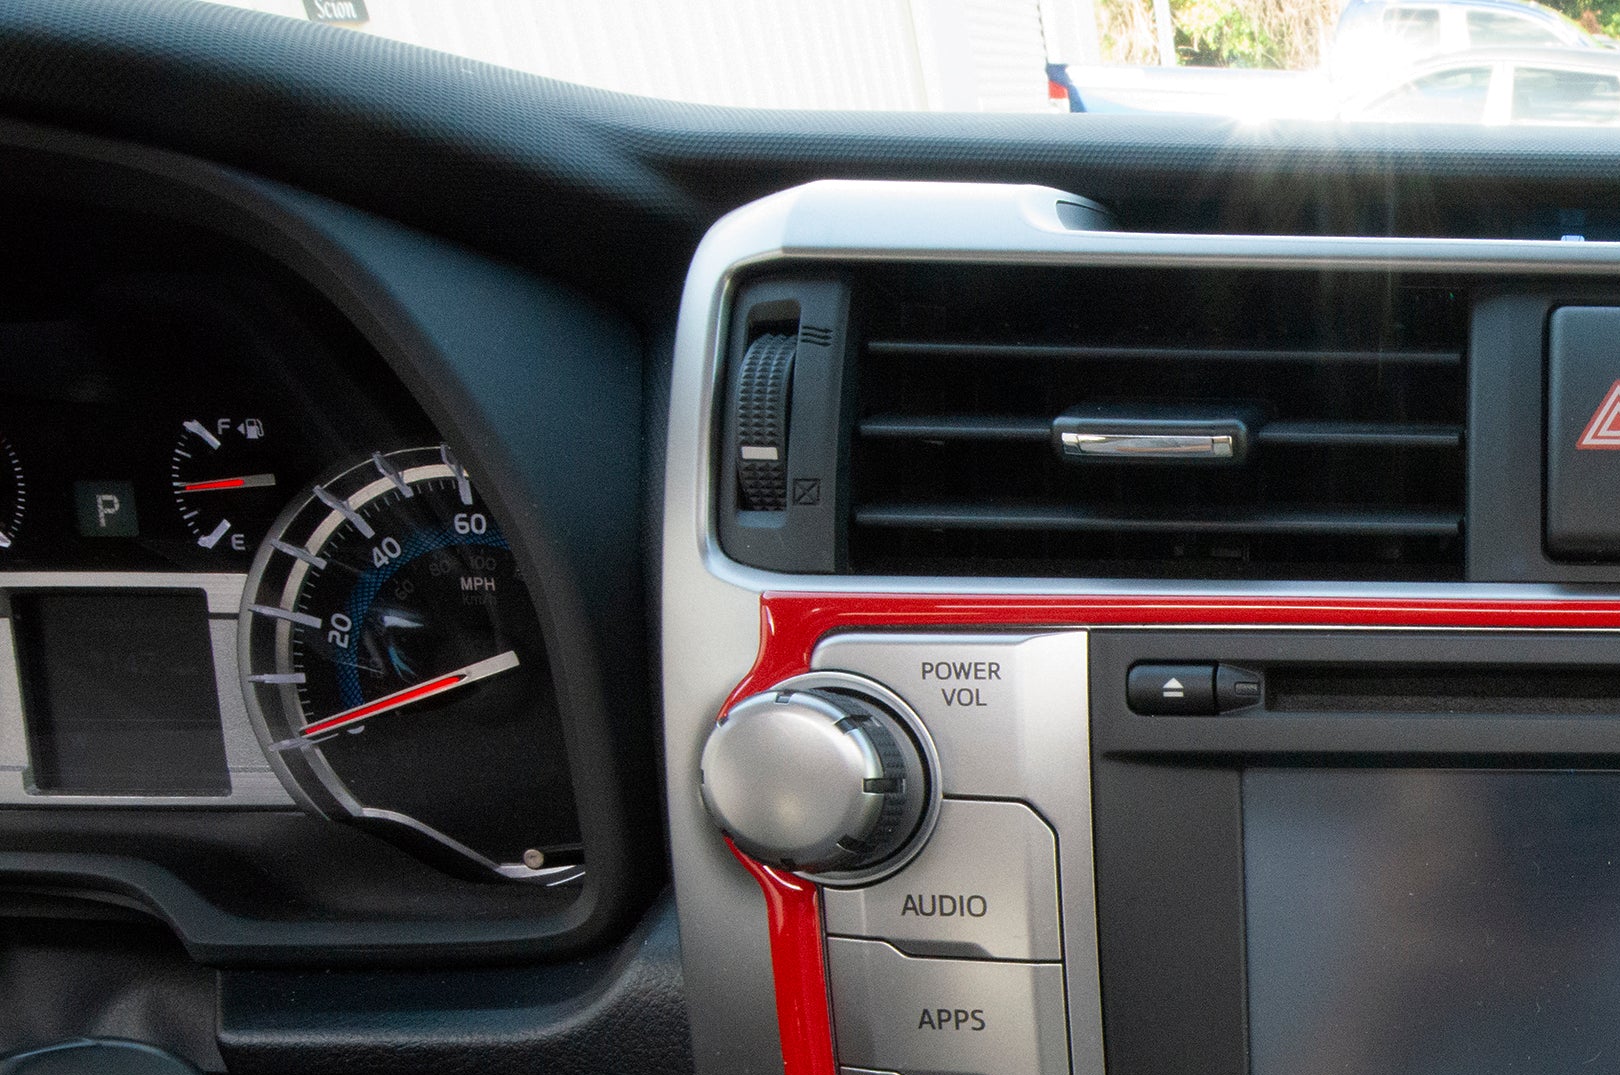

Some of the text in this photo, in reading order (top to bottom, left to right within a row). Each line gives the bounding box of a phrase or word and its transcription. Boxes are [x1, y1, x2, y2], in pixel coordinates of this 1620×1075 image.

[217, 419, 231, 435] F
[96, 494, 120, 527] P
[454, 513, 487, 535] 60
[231, 534, 246, 551] E
[372, 537, 402, 568] 40
[460, 576, 496, 592] MPH
[328, 613, 352, 648] 20
[921, 661, 1001, 680] POWER
[941, 688, 988, 707] VOL
[901, 895, 988, 917] AUDIO
[918, 1009, 986, 1032] APPS
